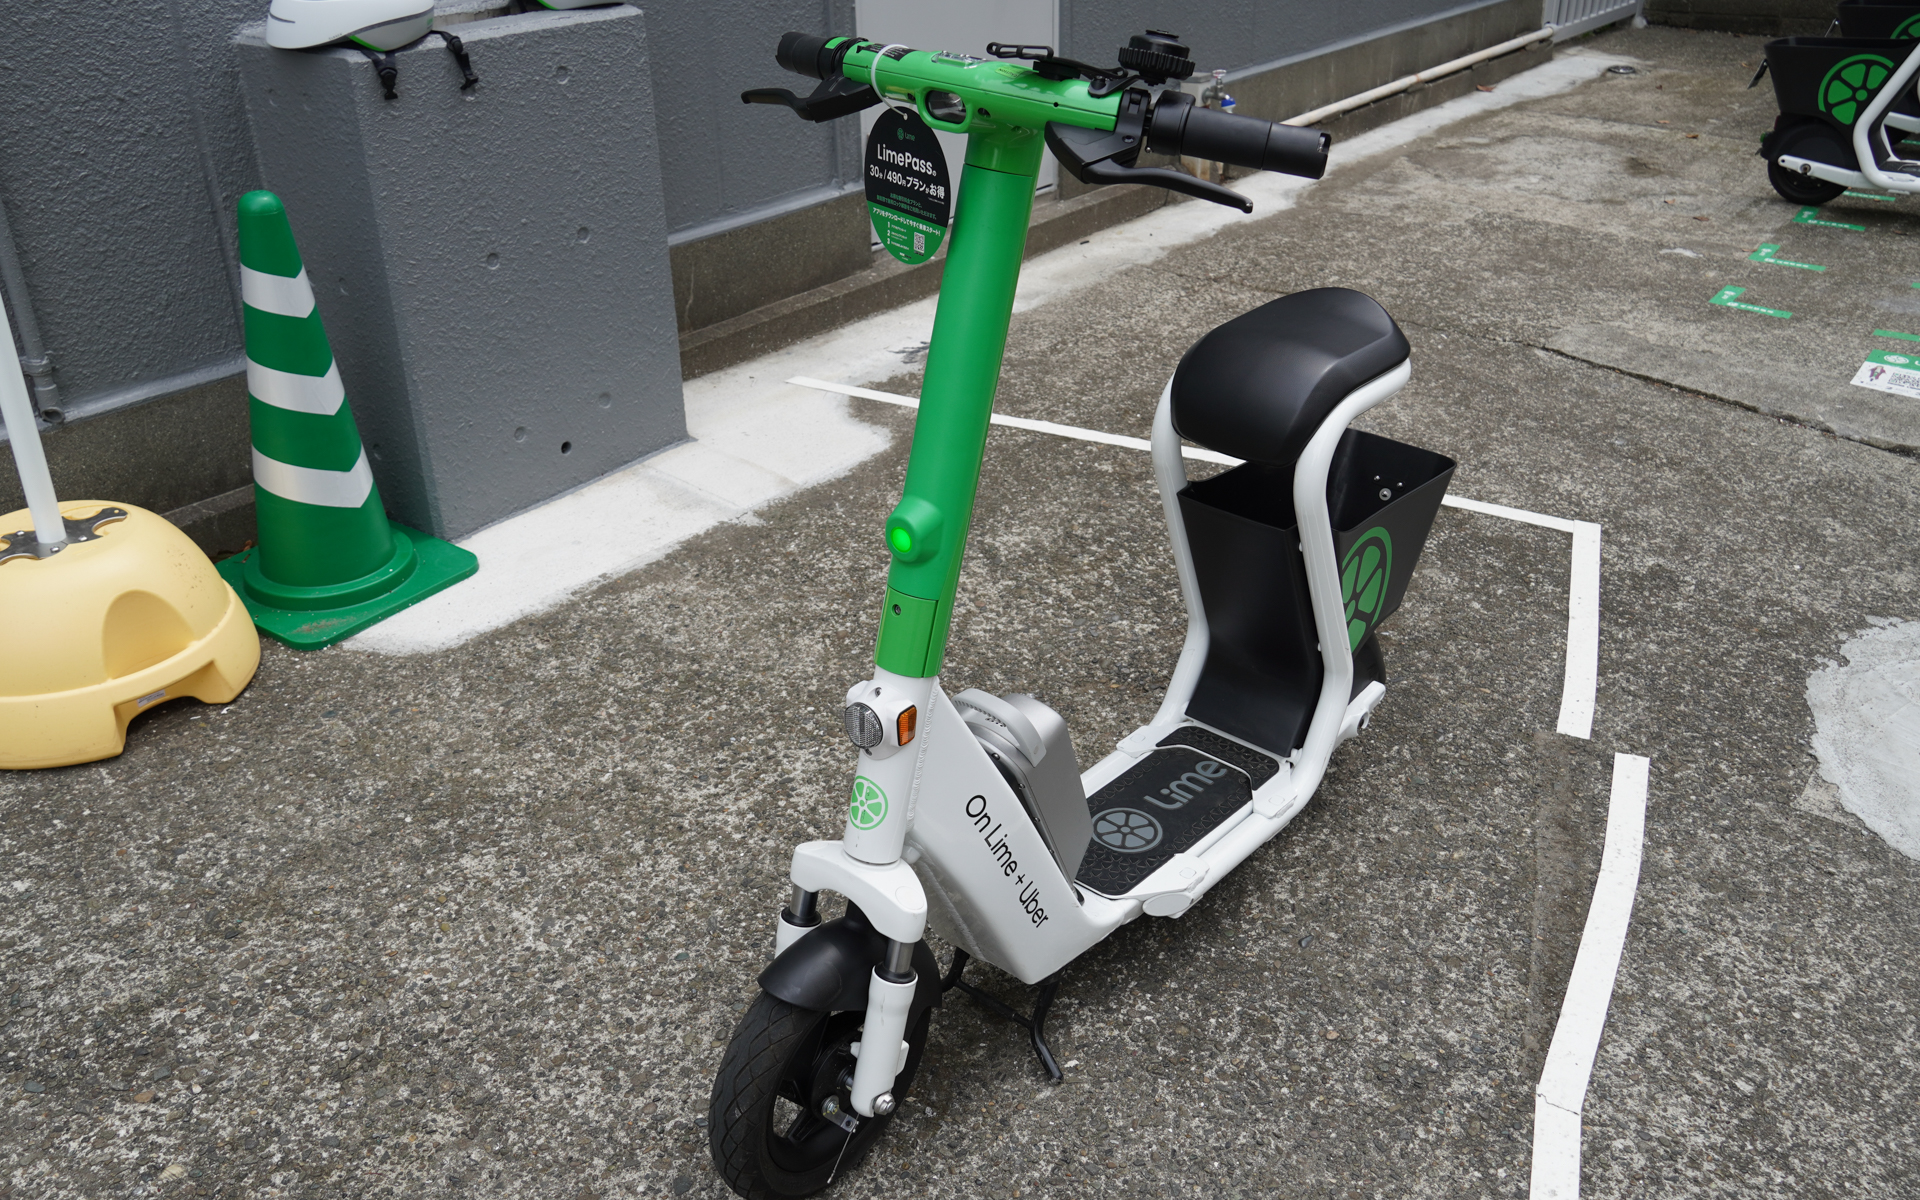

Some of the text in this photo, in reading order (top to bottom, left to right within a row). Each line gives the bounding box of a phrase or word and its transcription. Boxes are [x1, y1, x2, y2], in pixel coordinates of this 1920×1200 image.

[1143, 760, 1228, 810] Lime
[965, 794, 1049, 928] On Lime + Uber
